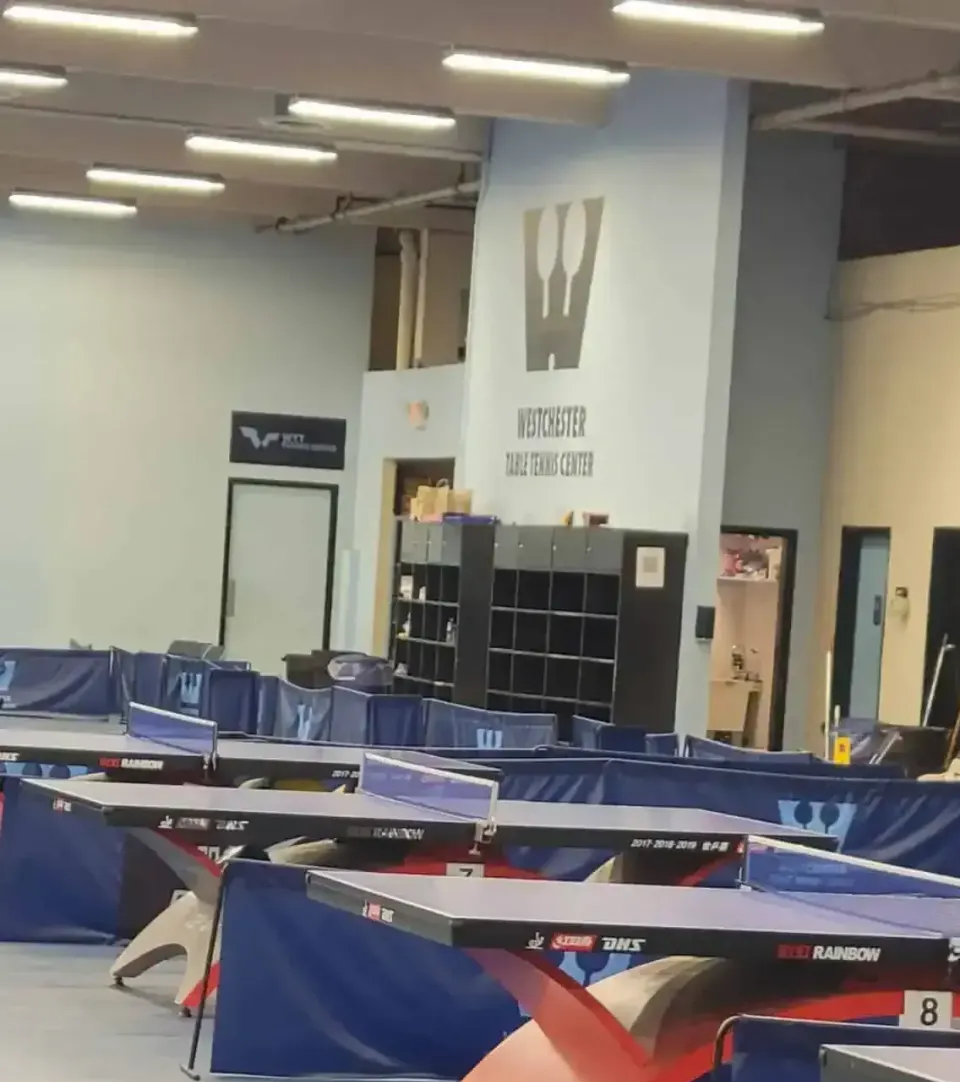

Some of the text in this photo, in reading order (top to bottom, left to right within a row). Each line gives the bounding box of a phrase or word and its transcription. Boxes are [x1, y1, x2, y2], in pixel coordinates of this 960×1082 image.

[517, 405, 587, 439] WESTCHESTER
[505, 451, 594, 478] TABLE TENNIS CENTER
[601, 937, 647, 952] DHS
[812, 945, 882, 963] RAINBOW
[920, 996, 939, 1027] 8
